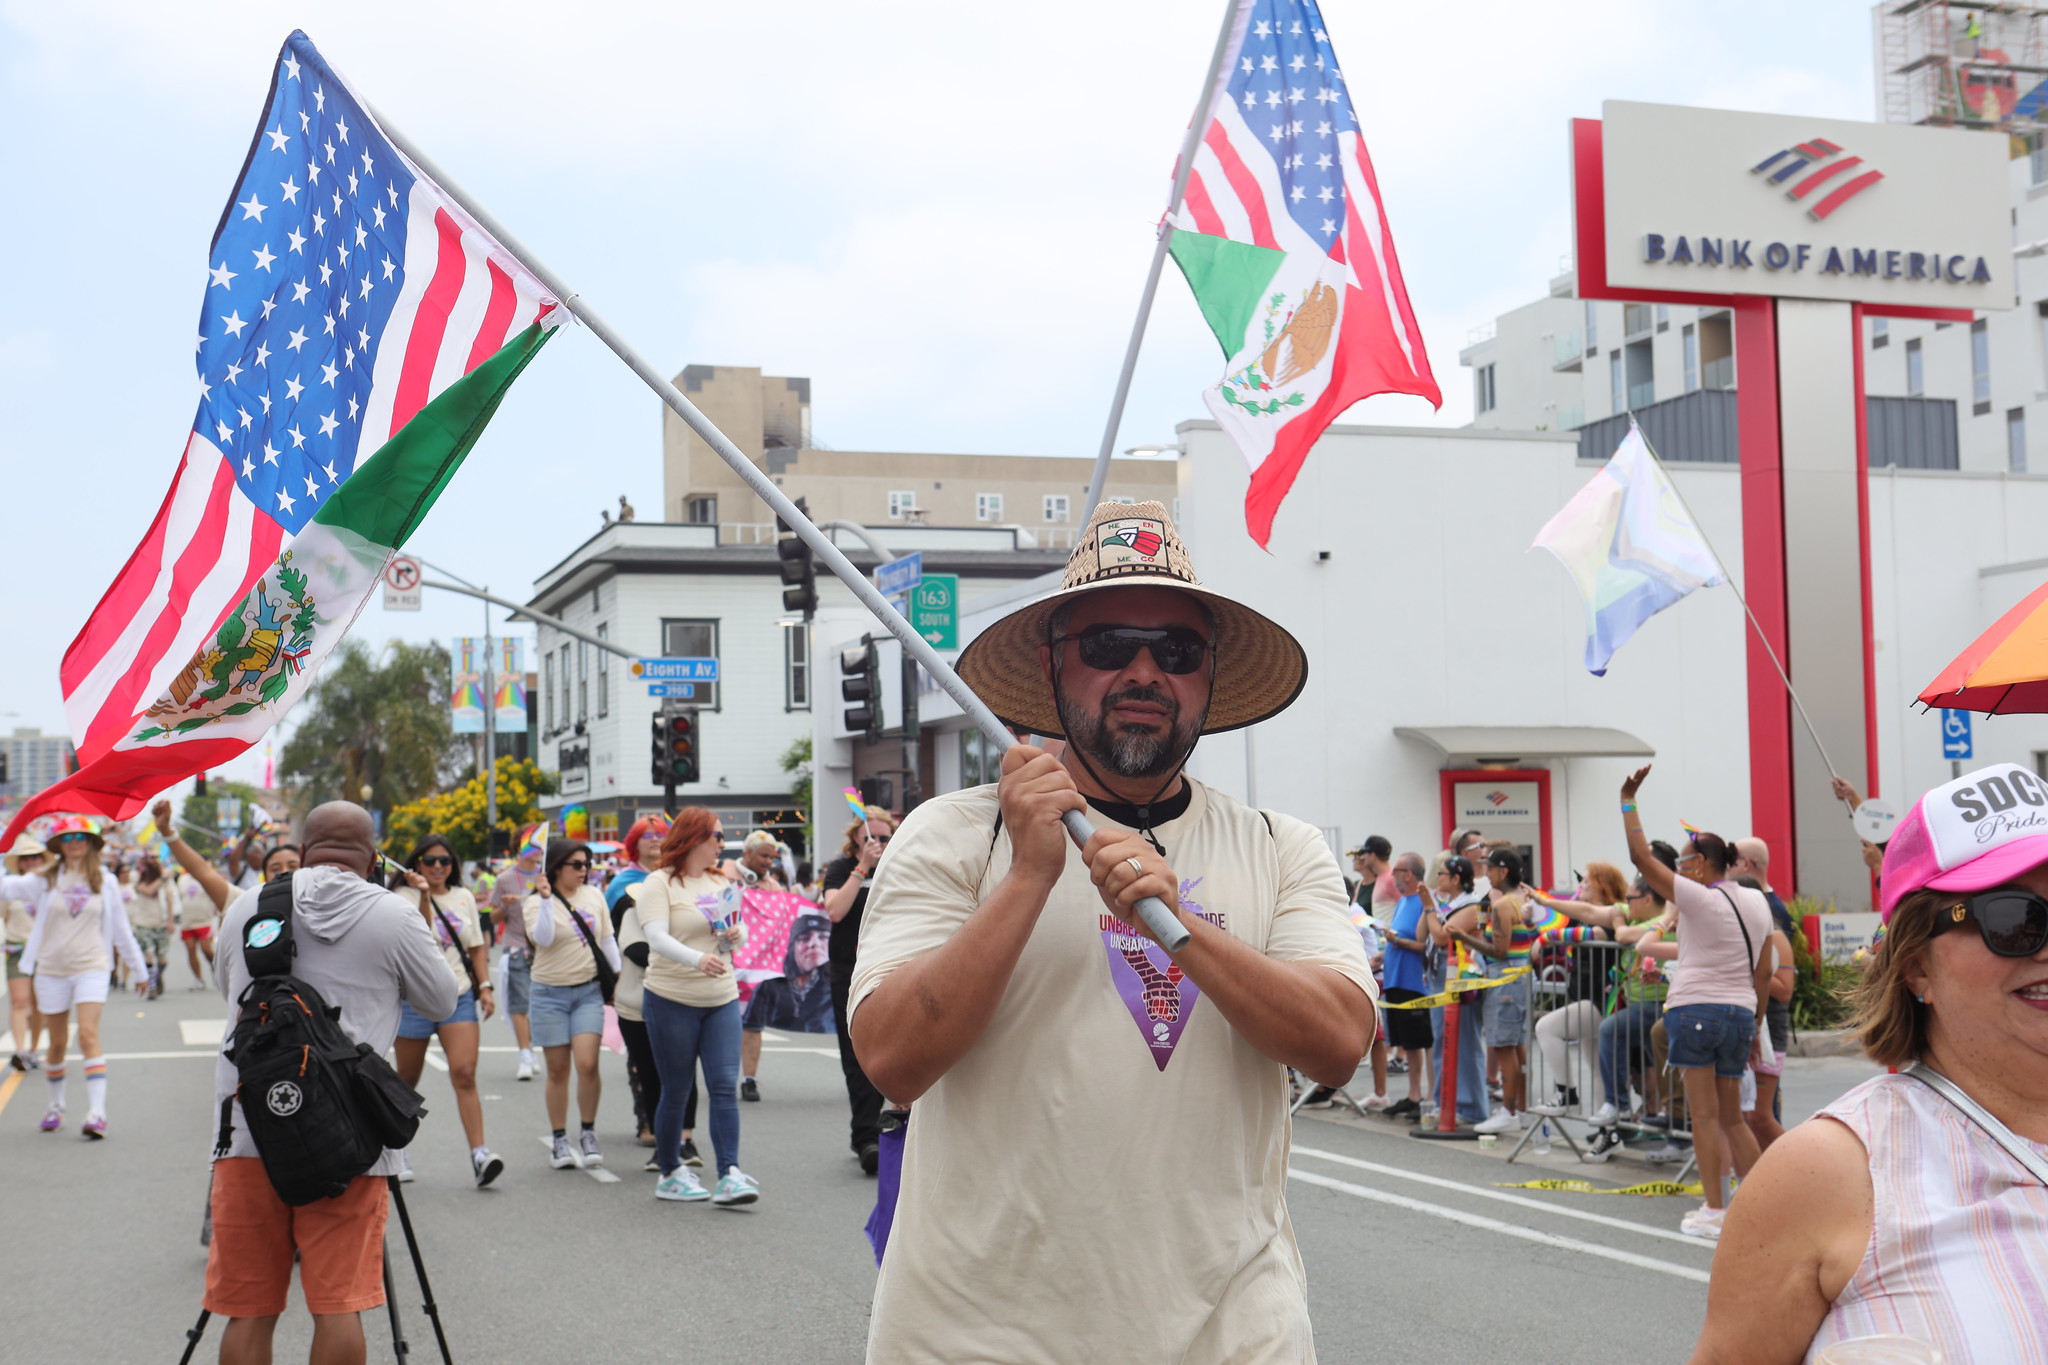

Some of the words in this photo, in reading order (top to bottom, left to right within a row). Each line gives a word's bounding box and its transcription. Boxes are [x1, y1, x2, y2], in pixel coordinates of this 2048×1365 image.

[1645, 233, 1754, 268] BANK
[1765, 242, 1812, 271] OF
[1824, 246, 1993, 283] AMERICA
[1142, 521, 1154, 529] EN
[921, 590, 947, 606] 163
[919, 612, 950, 627] SOUTH
[1975, 811, 2047, 844] Pride
[1099, 913, 1139, 938] UNBRE
[1195, 912, 1227, 931] IDE
[1824, 922, 1846, 932] Bank
[1110, 933, 1158, 952] UNSHAKEA
